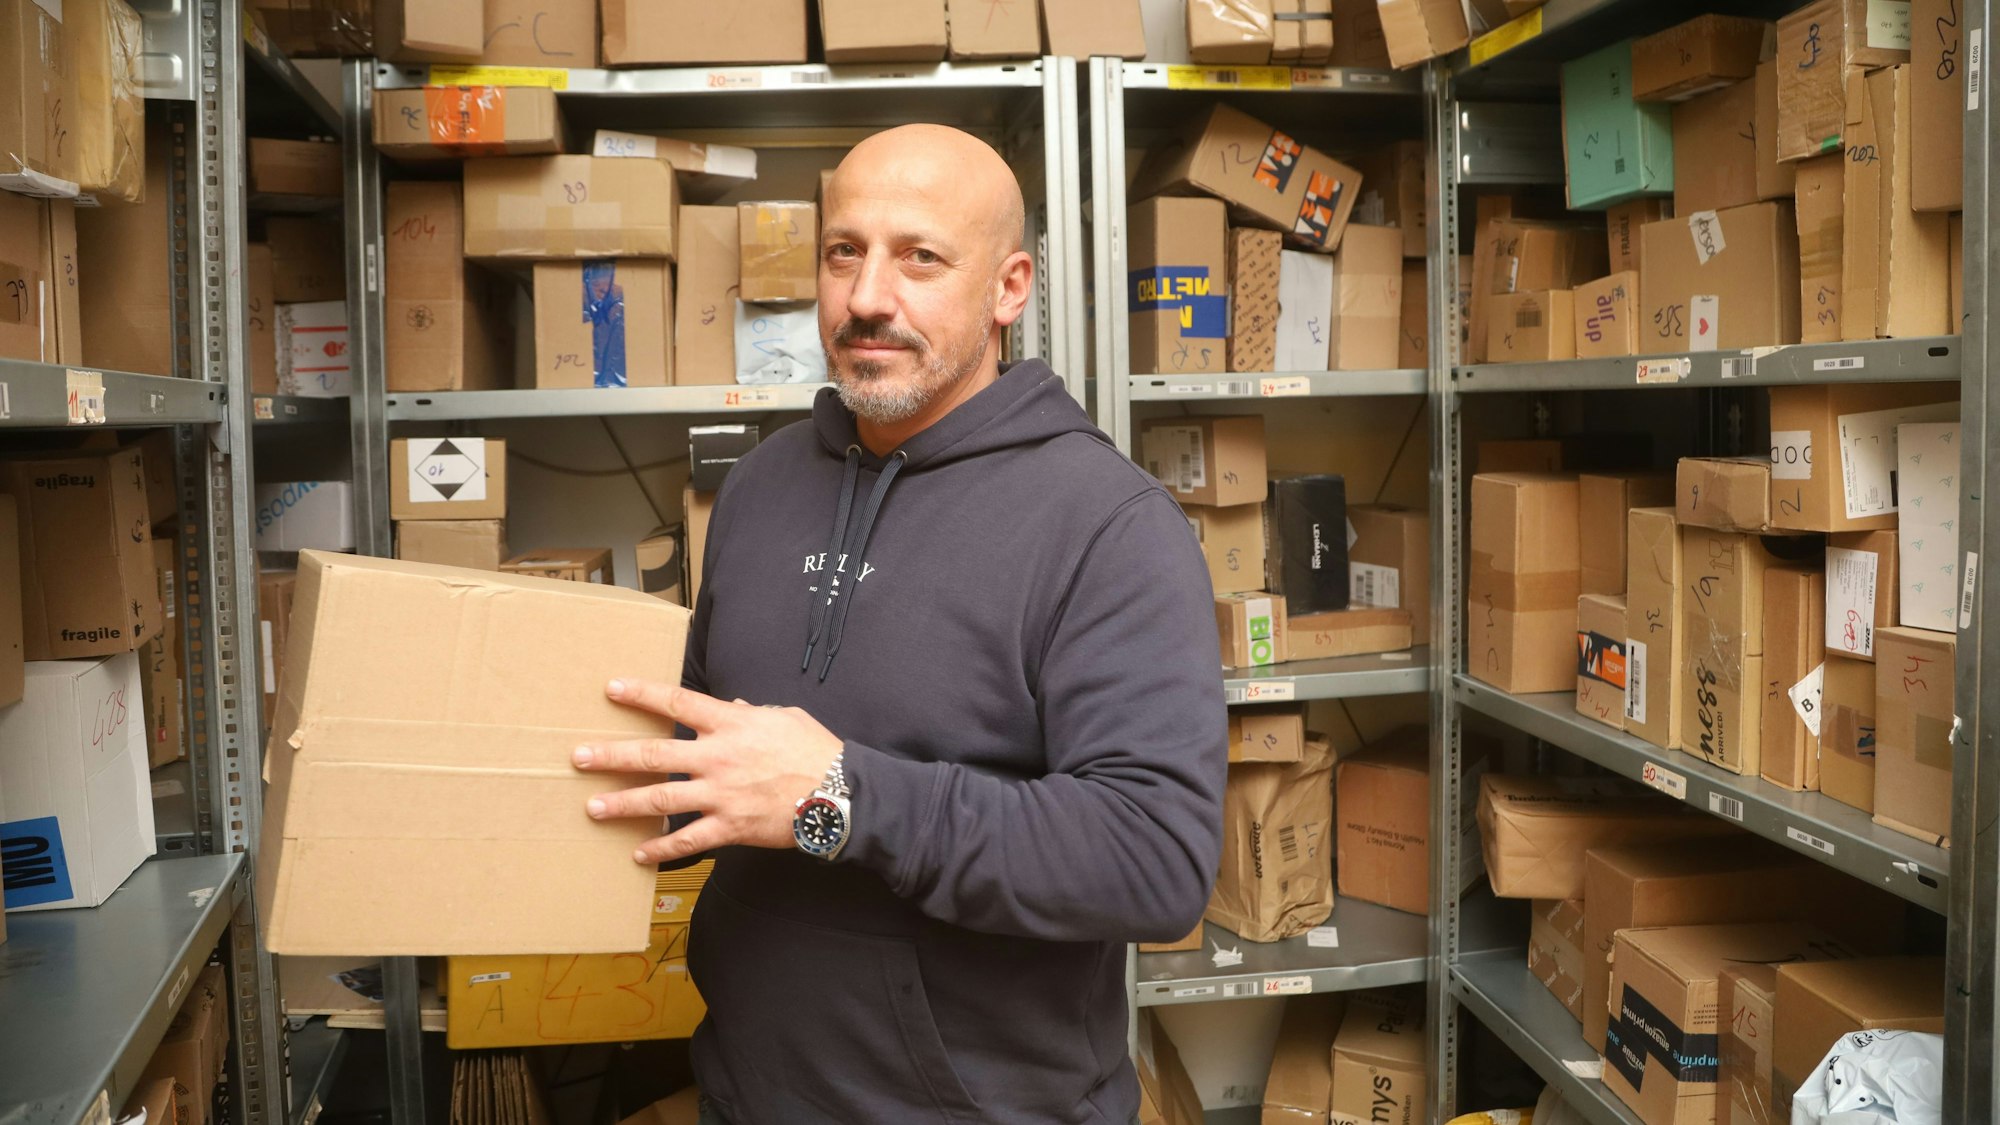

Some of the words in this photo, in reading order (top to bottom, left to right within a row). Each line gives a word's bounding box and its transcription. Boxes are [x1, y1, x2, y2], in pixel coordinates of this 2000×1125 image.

[563, 181, 587, 204] 89
[1596, 295, 1615, 322] air
[1585, 317, 1602, 342] up
[1638, 365, 1648, 378] 29
[1263, 384, 1275, 394] 24
[34, 474, 95, 488] fragile
[1313, 523, 1321, 569] LEHMANN
[1646, 607, 1663, 633] 36
[61, 627, 120, 642] fragile
[1903, 655, 1934, 693] 34
[1248, 686, 1260, 698] 25
[92, 682, 127, 752] 428
[1801, 698, 1814, 713] B
[1251, 821, 1263, 879] amazon
[1265, 982, 1279, 992] 26
[476, 984, 504, 1031] A
[1732, 1005, 1757, 1038] 15
[1672, 1050, 1707, 1069] prime
